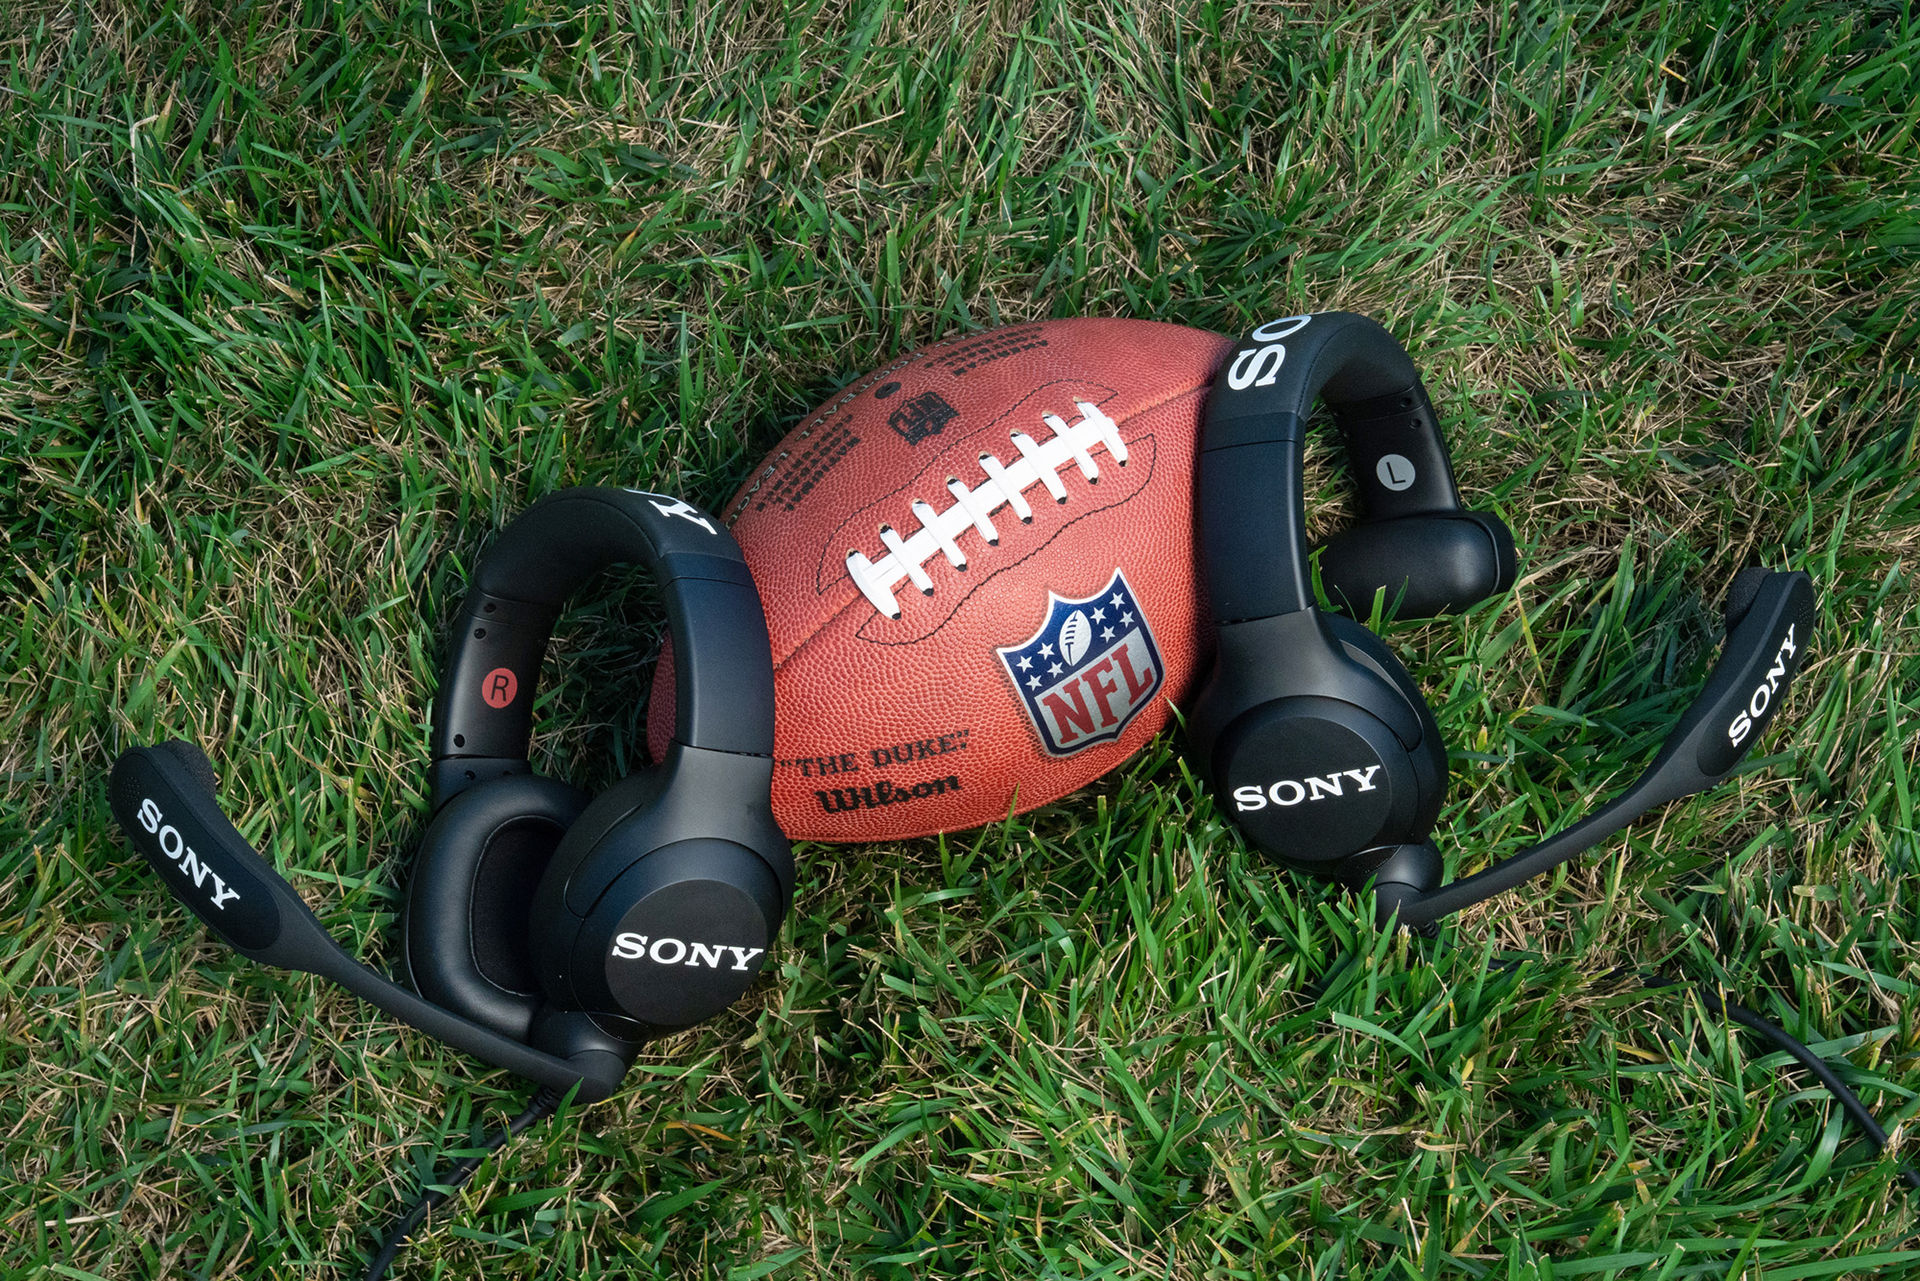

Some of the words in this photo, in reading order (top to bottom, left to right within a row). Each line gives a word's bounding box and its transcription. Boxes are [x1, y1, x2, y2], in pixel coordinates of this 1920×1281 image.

[1386, 461, 1406, 484] L
[491, 674, 509, 701] R
[1041, 643, 1154, 745] NFL
[1729, 622, 1799, 749] SONY
[814, 775, 962, 814] Wilson
[1233, 764, 1381, 813] SONY
[137, 797, 241, 911] SONY
[611, 932, 764, 972] SONY
